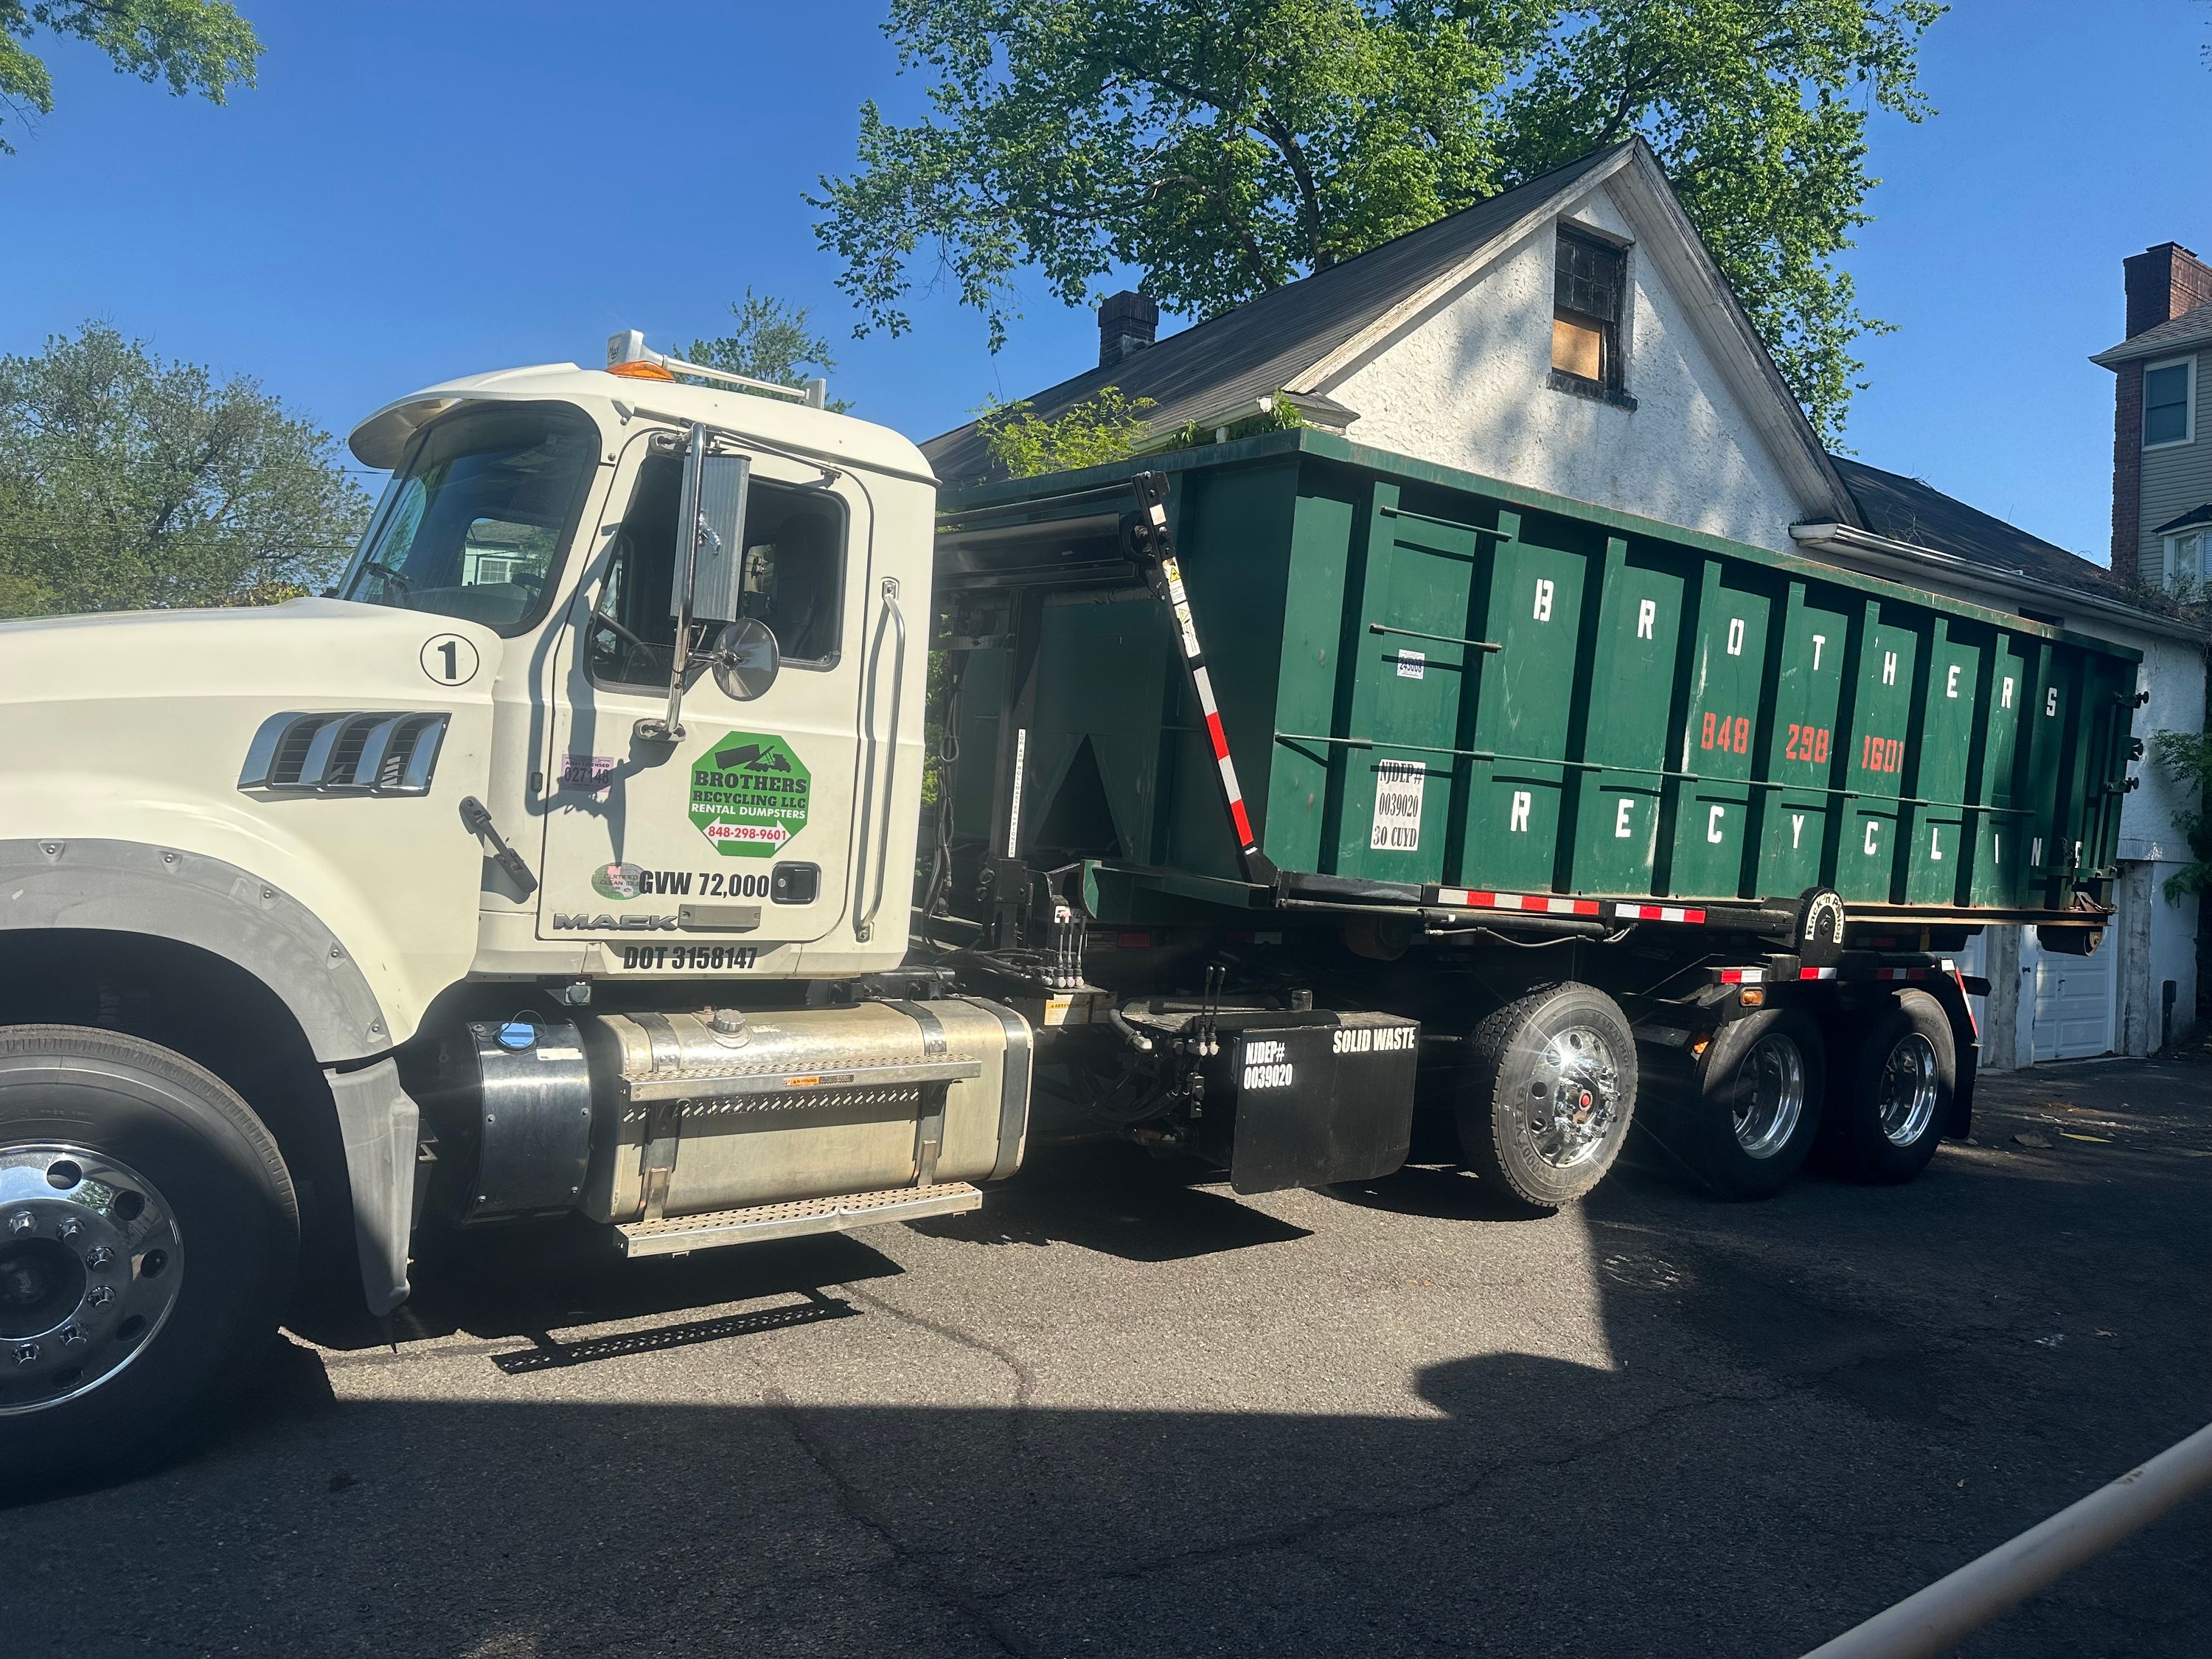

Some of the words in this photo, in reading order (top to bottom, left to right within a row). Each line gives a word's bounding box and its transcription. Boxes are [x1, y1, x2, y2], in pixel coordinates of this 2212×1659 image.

[1533, 578, 2058, 717] BROTHERS
[437, 641, 456, 679] 1
[1700, 712, 1750, 754] 848
[1786, 724, 1829, 763] 298
[565, 766, 609, 783] 027148
[694, 771, 807, 793] BROTHERS
[692, 790, 777, 806] RECYCLING
[781, 796, 806, 808] LLC
[1379, 793, 1419, 818] 0039020
[691, 803, 736, 815] RENTAL
[740, 806, 806, 819] DUMPSTERS
[708, 826, 786, 841] 848-298-9601
[1373, 825, 1388, 846] 30
[1391, 827, 1417, 847] CUYD
[639, 871, 692, 894] GVW
[699, 873, 770, 898] 72,000
[553, 913, 678, 931] MACK
[623, 947, 668, 969] DOT
[672, 947, 758, 970] 3158147
[1333, 1030, 1371, 1054] SOLID
[1374, 1027, 1416, 1051] WASTE
[1245, 1041, 1285, 1065] NJDEP#
[1243, 1063, 1293, 1090] 0039020
